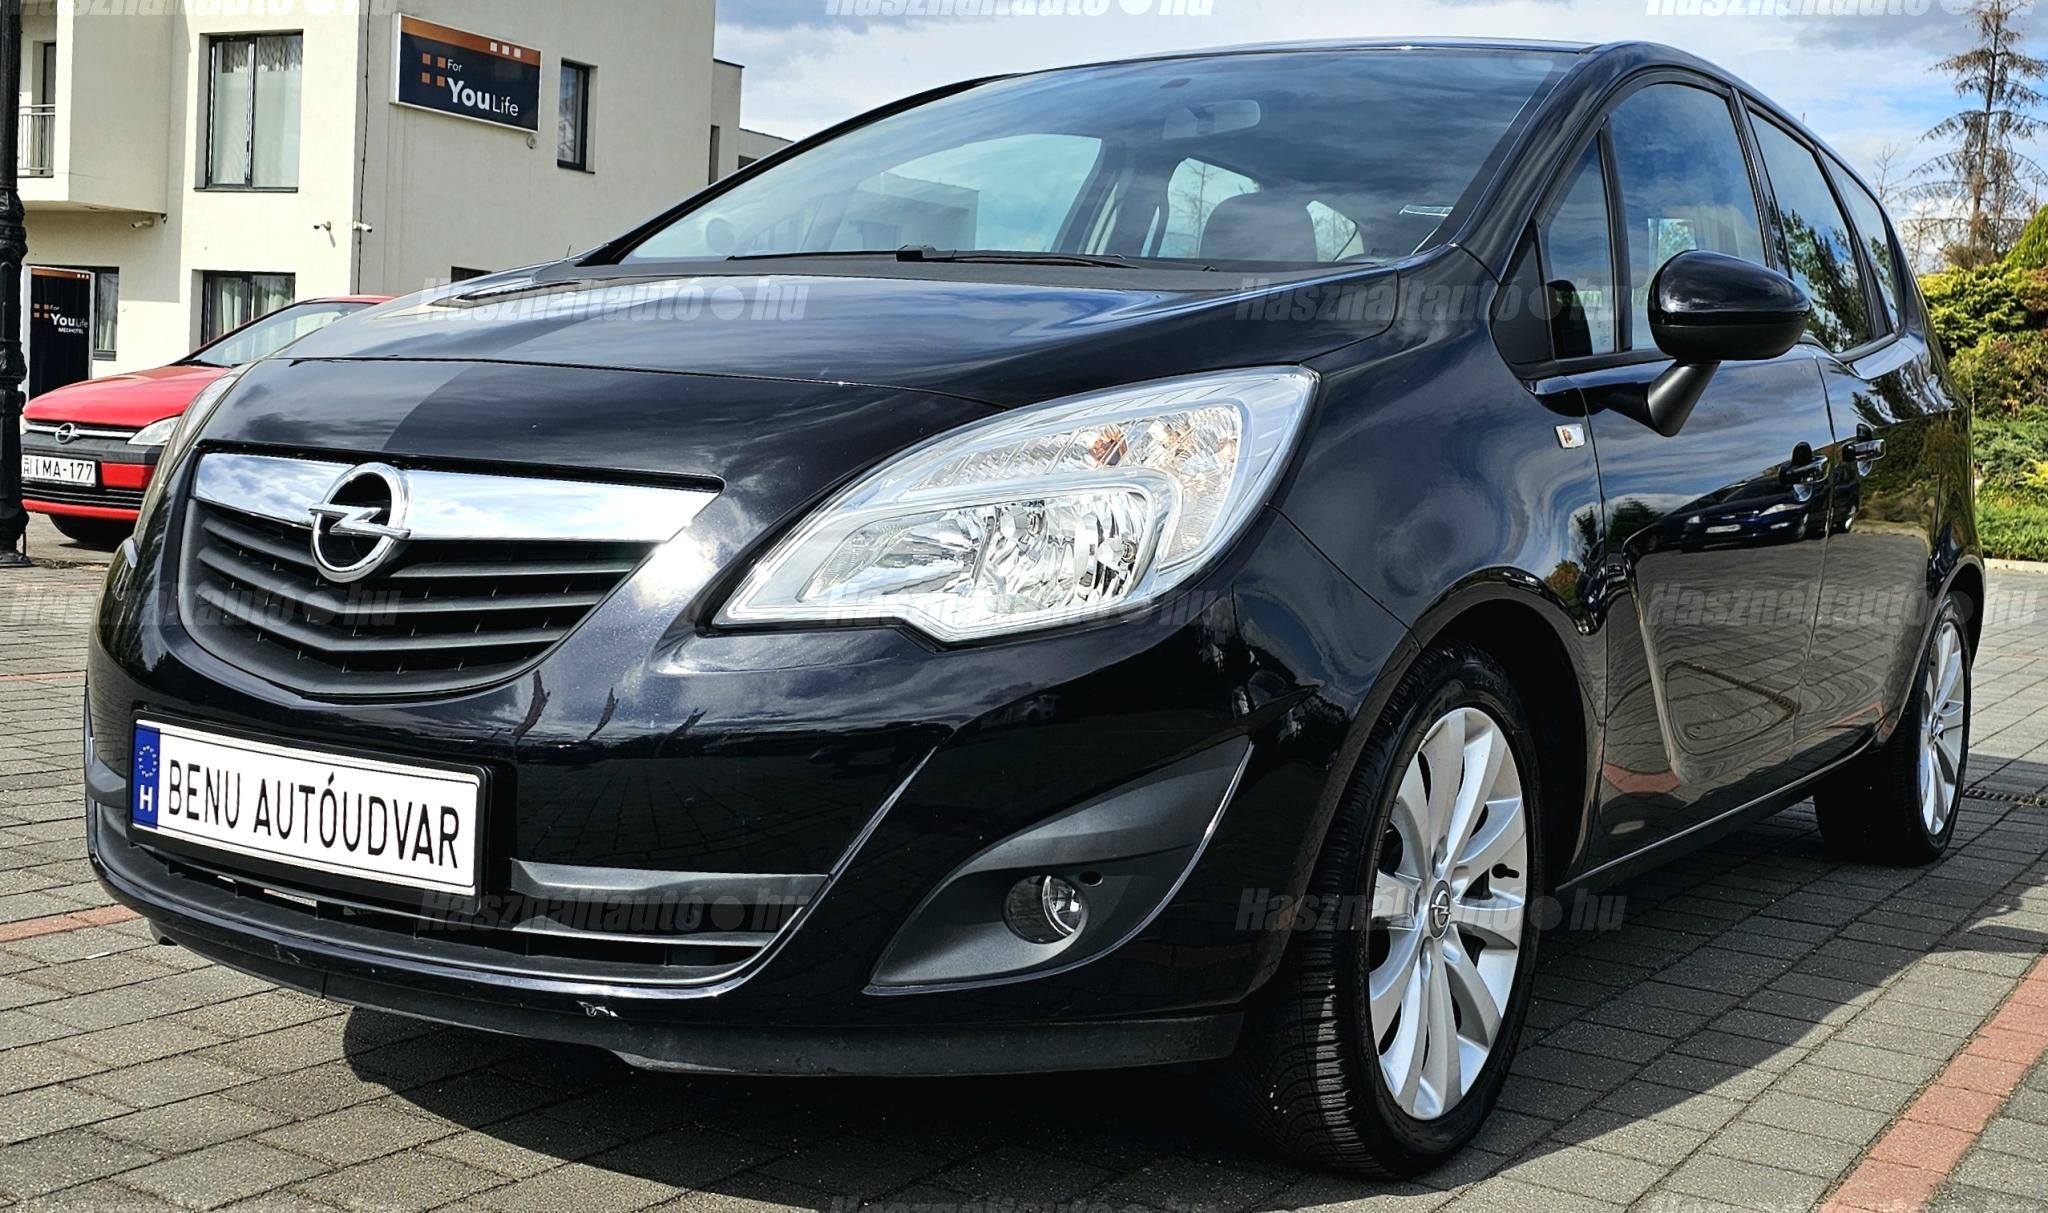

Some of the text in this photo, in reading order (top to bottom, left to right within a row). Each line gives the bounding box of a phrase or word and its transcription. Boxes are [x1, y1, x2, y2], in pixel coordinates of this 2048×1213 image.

[447, 59, 463, 73] For
[36, 458, 93, 481] IMA-177
[139, 759, 460, 868] H BENU AUTÓUDVAR
